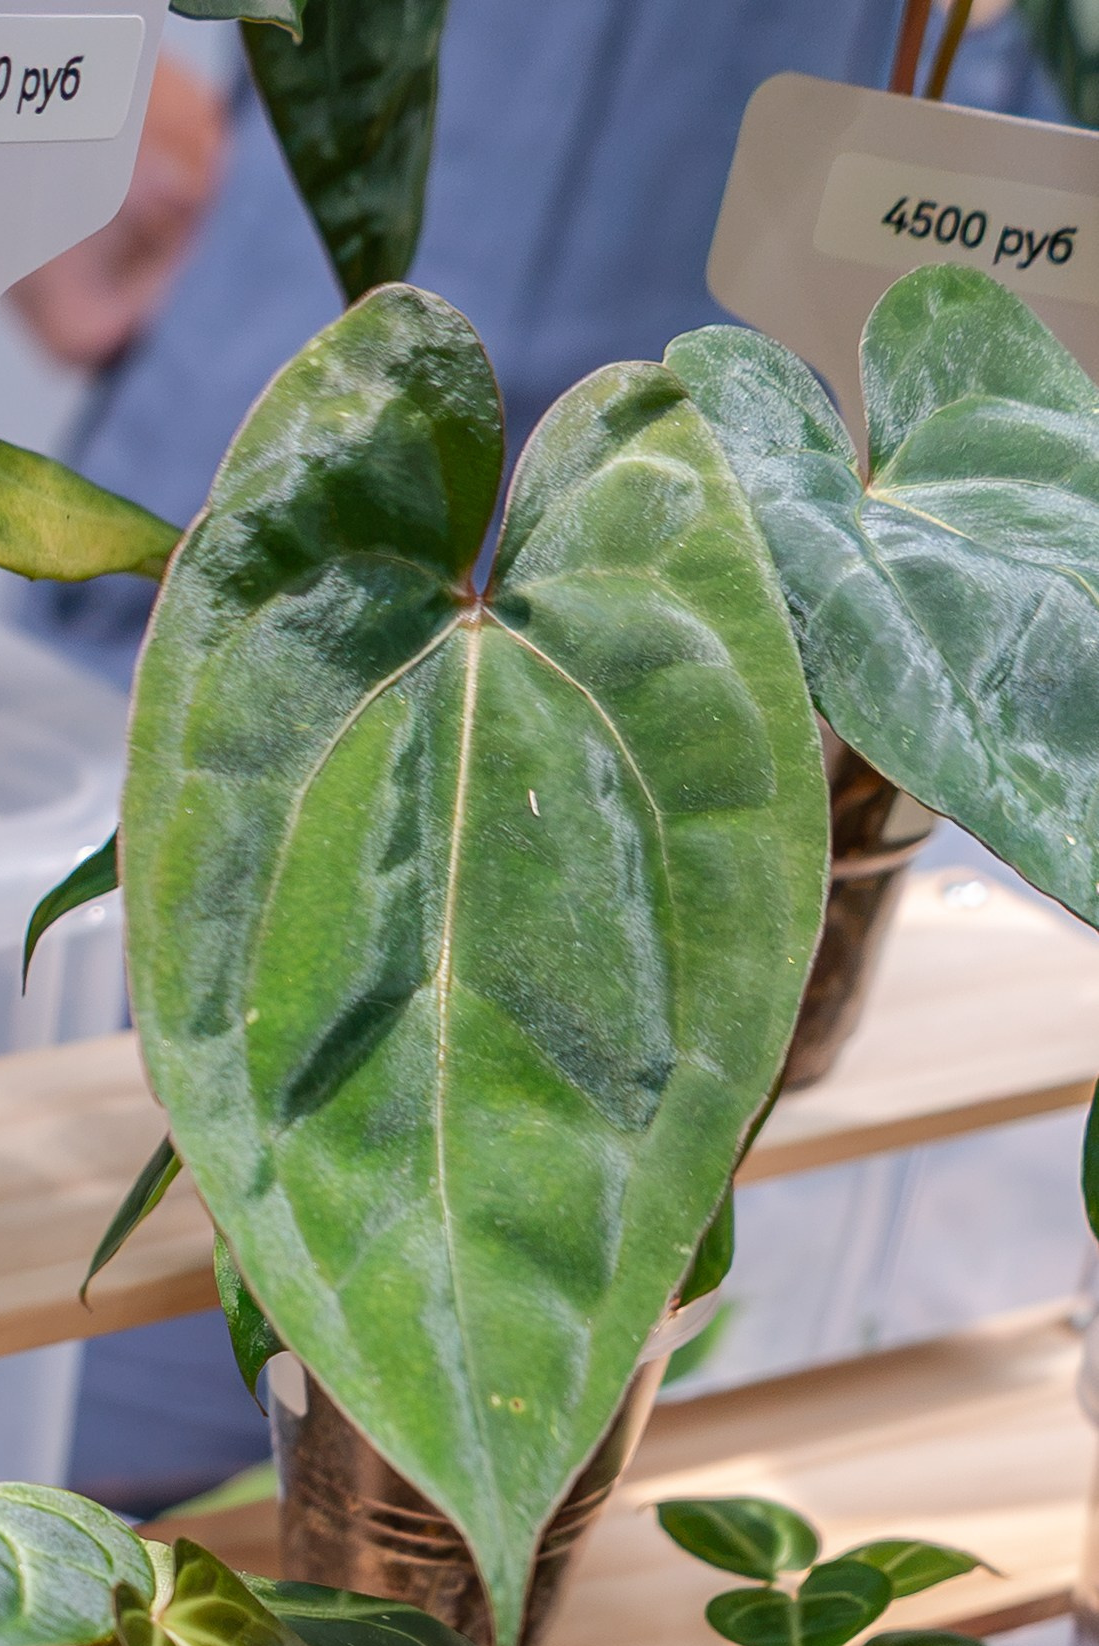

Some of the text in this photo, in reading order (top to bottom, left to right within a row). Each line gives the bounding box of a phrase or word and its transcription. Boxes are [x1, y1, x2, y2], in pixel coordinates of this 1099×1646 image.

[16, 54, 85, 115] руб
[881, 196, 1079, 270] 4500 руб
